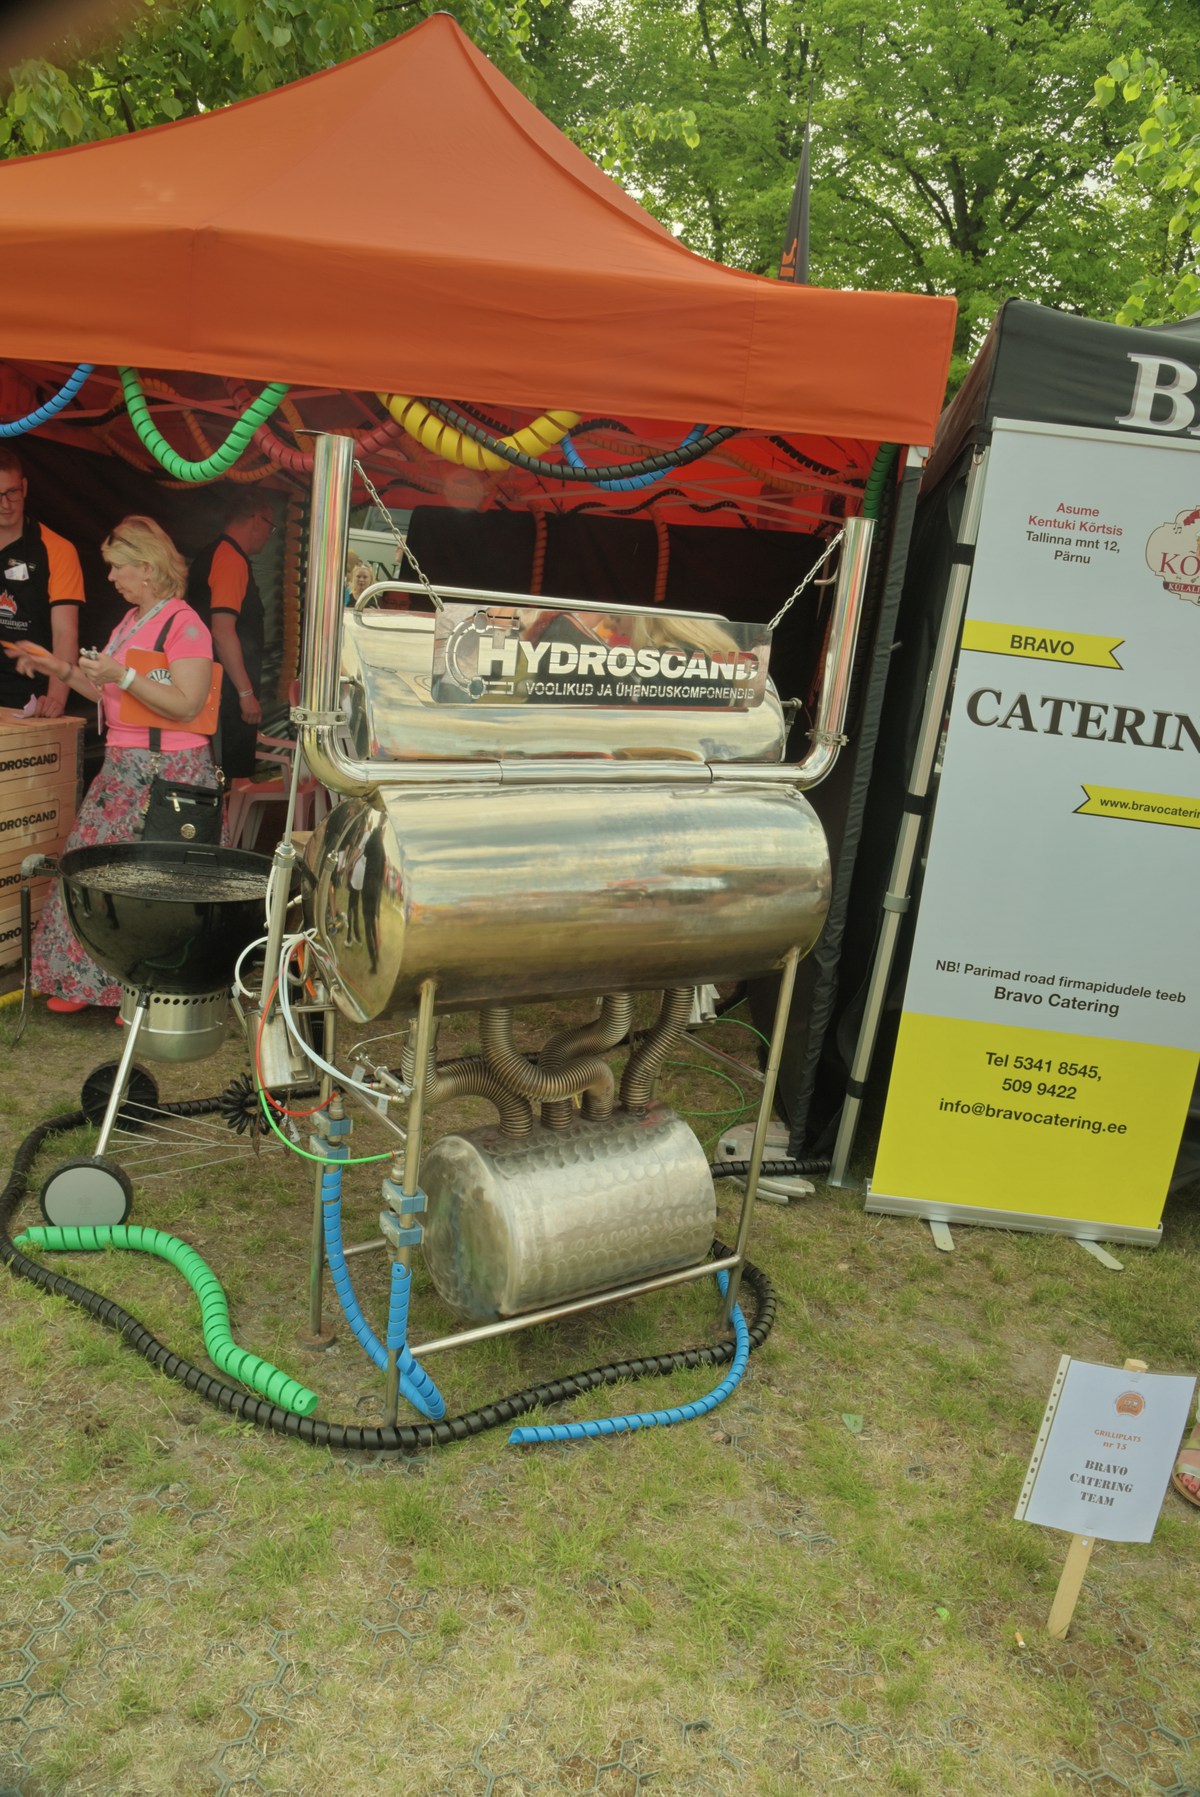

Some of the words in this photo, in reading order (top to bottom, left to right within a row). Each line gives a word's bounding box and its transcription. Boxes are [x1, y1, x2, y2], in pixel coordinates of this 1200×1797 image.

[1114, 352, 1200, 436] B
[1056, 503, 1099, 518] Asume
[1028, 516, 1075, 531] Kentuki
[1079, 519, 1123, 537] Kõrtsis
[1026, 531, 1071, 549] Tallinna
[1075, 538, 1099, 549] mnt
[1103, 540, 1121, 553] 12,
[1054, 551, 1091, 565] Pärnu
[1009, 634, 1075, 656] BRAVO
[477, 636, 760, 680] HYDROSCAND
[526, 682, 594, 697] VOOLIKUD
[597, 682, 612, 696] JA
[616, 682, 755, 699] ÜHENDUSKOMPONENDID
[935, 959, 961, 974] NB!
[964, 963, 1021, 981] Parimad
[1024, 973, 1055, 986] road
[1058, 976, 1152, 999] firmapidudele
[1155, 989, 1187, 1004] teeb
[993, 985, 1043, 1005] Bravo
[1047, 992, 1121, 1018] Catering
[985, 1051, 1009, 1068] Tel
[1013, 1056, 1053, 1073] 5341
[1057, 1061, 1103, 1082] 8545,
[1001, 1077, 1033, 1094] 509
[1036, 1082, 1078, 1100] 9422
[939, 1097, 1128, 1135] info@bravocatering.ee
[1094, 1428, 1142, 1443] GRILLIPLATS
[1102, 1440, 1114, 1448] nr
[1116, 1441, 1128, 1451] 15
[1085, 1459, 1128, 1477] BRAVO
[1069, 1472, 1134, 1494] CATERING
[1080, 1490, 1115, 1507] TEAM
